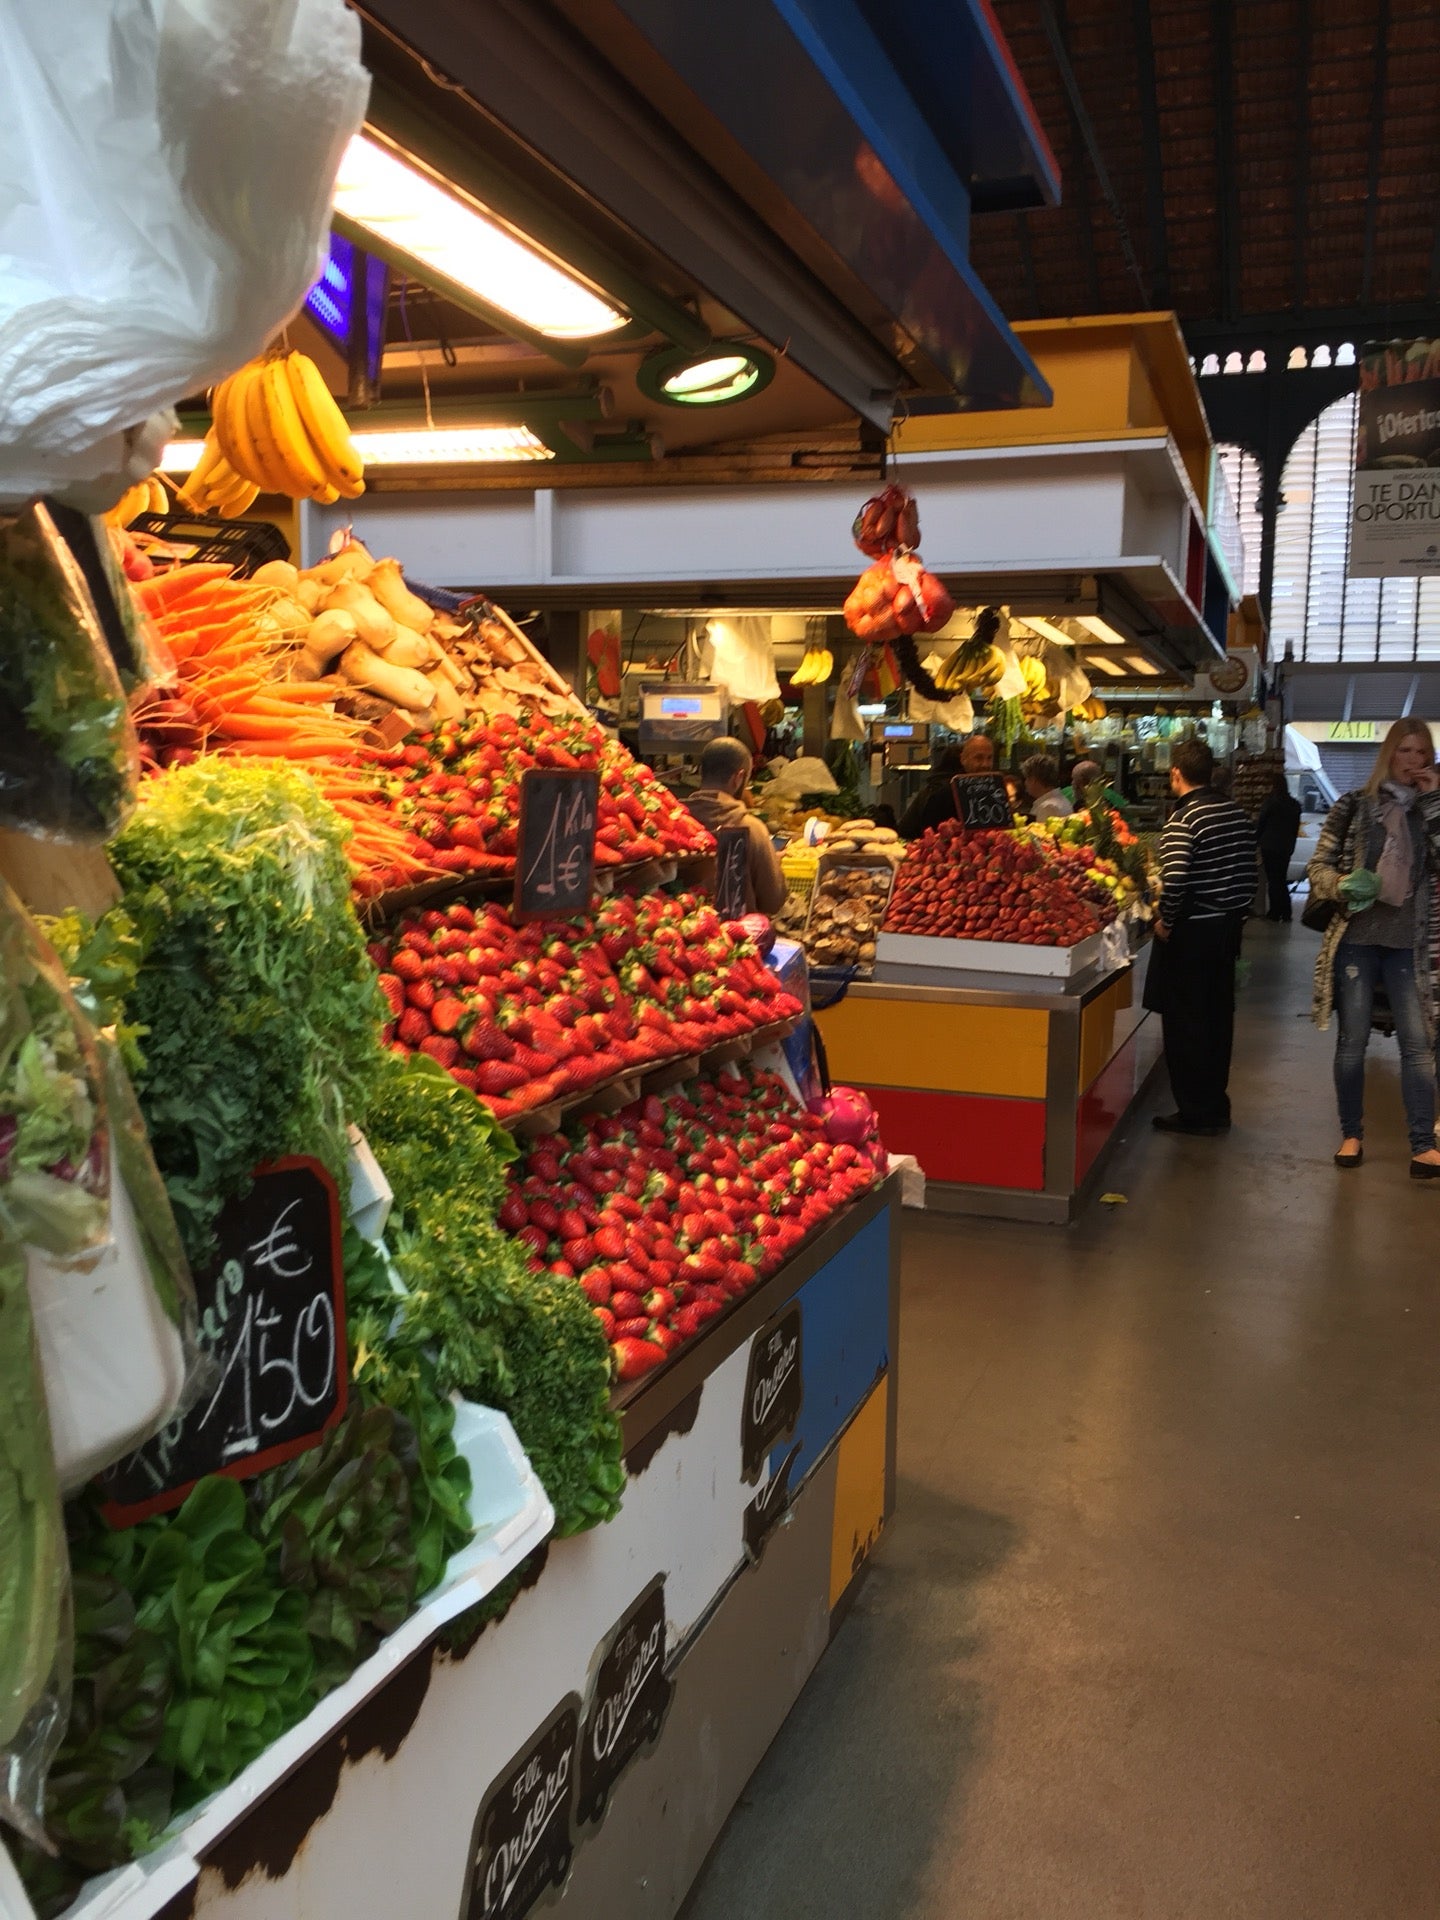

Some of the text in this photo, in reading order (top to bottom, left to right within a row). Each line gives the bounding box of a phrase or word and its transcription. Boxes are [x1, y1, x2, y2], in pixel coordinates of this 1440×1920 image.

[1368, 484, 1392, 503] TE
[557, 844, 584, 891] €
[247, 1198, 313, 1277] €
[593, 1620, 662, 1762] Orsero
[484, 1744, 573, 1914] Orsero
